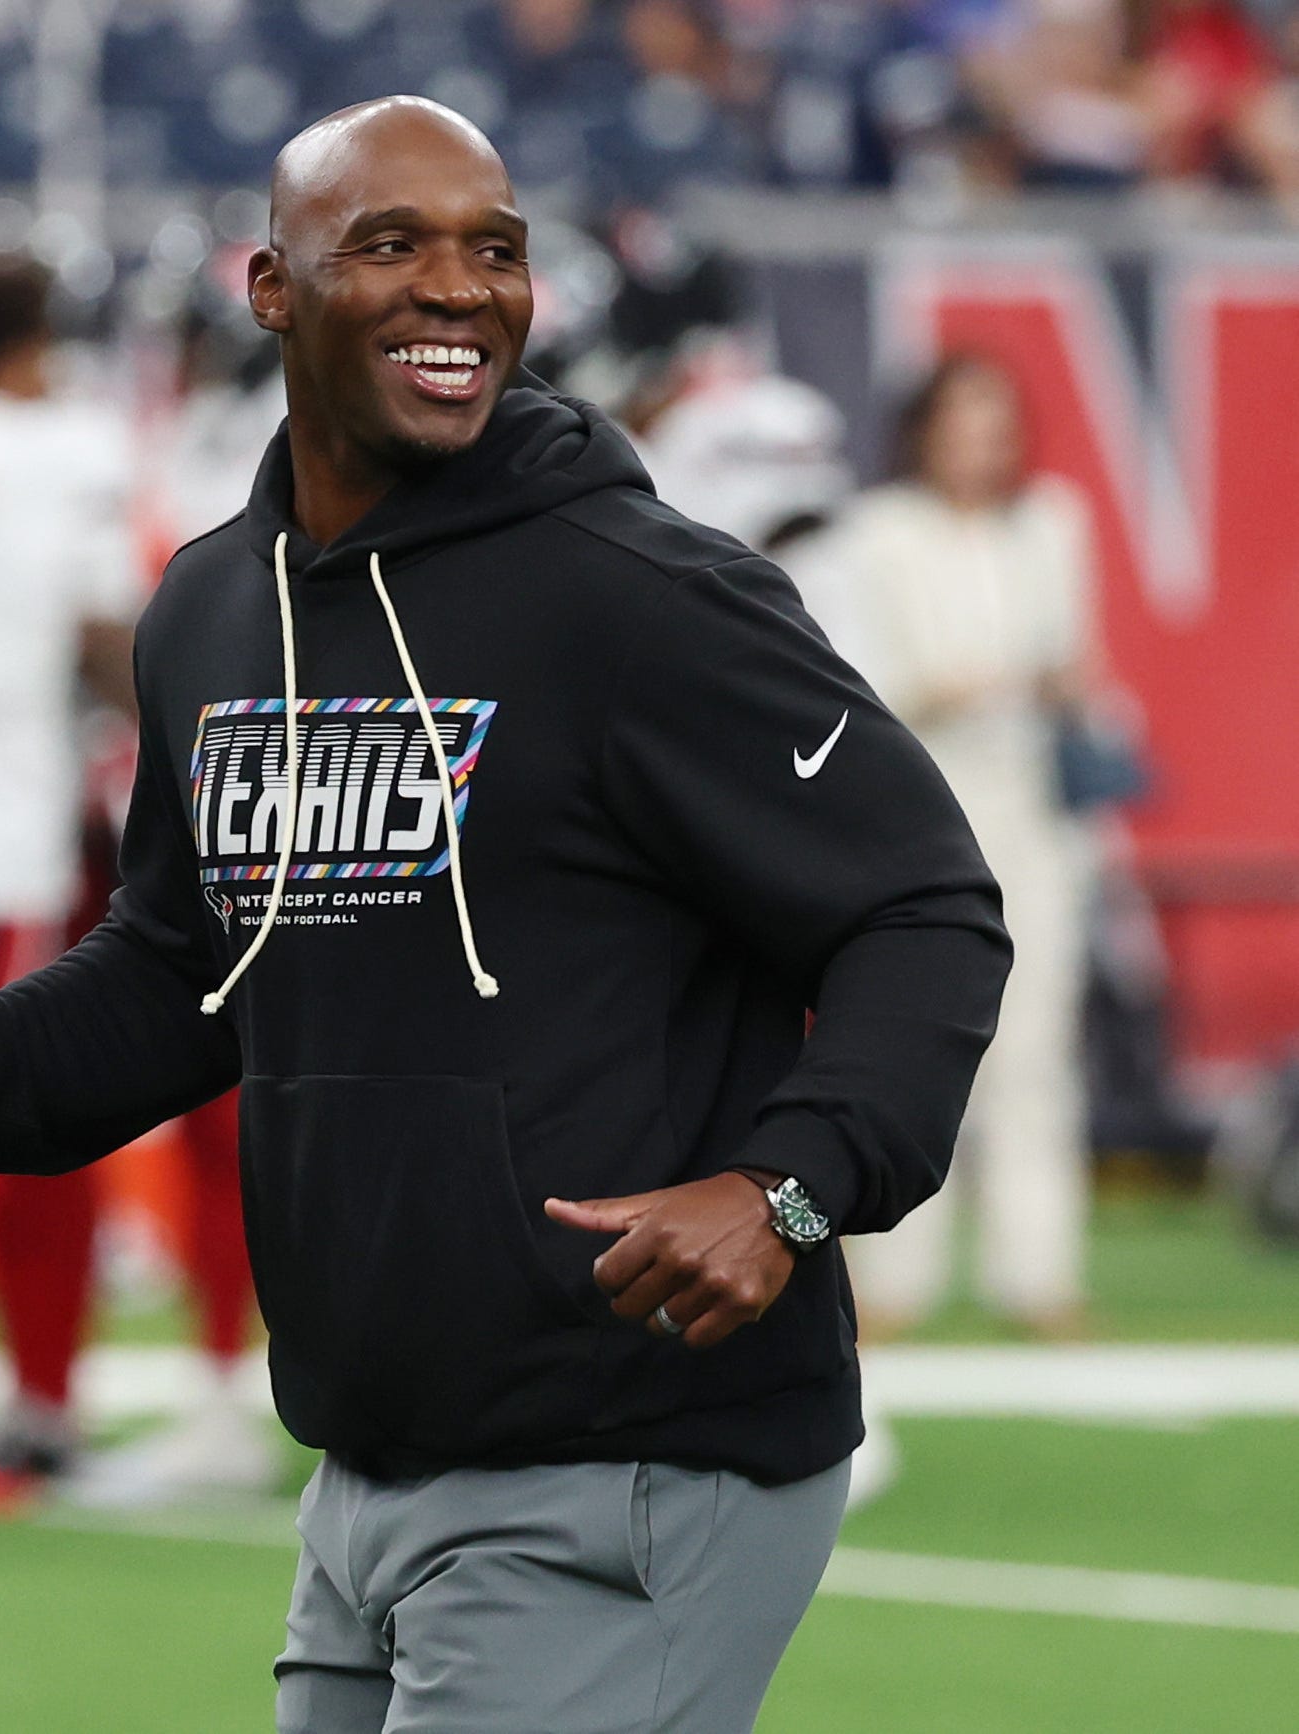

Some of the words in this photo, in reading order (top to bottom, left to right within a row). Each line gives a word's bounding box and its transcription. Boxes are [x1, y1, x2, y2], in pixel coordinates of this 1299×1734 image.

[200, 723, 462, 857] TEXANS
[236, 893, 327, 908] INTECEPT
[332, 890, 422, 906] CANCER
[239, 915, 291, 926] HOUSON
[293, 913, 358, 925] FOOTBALL
